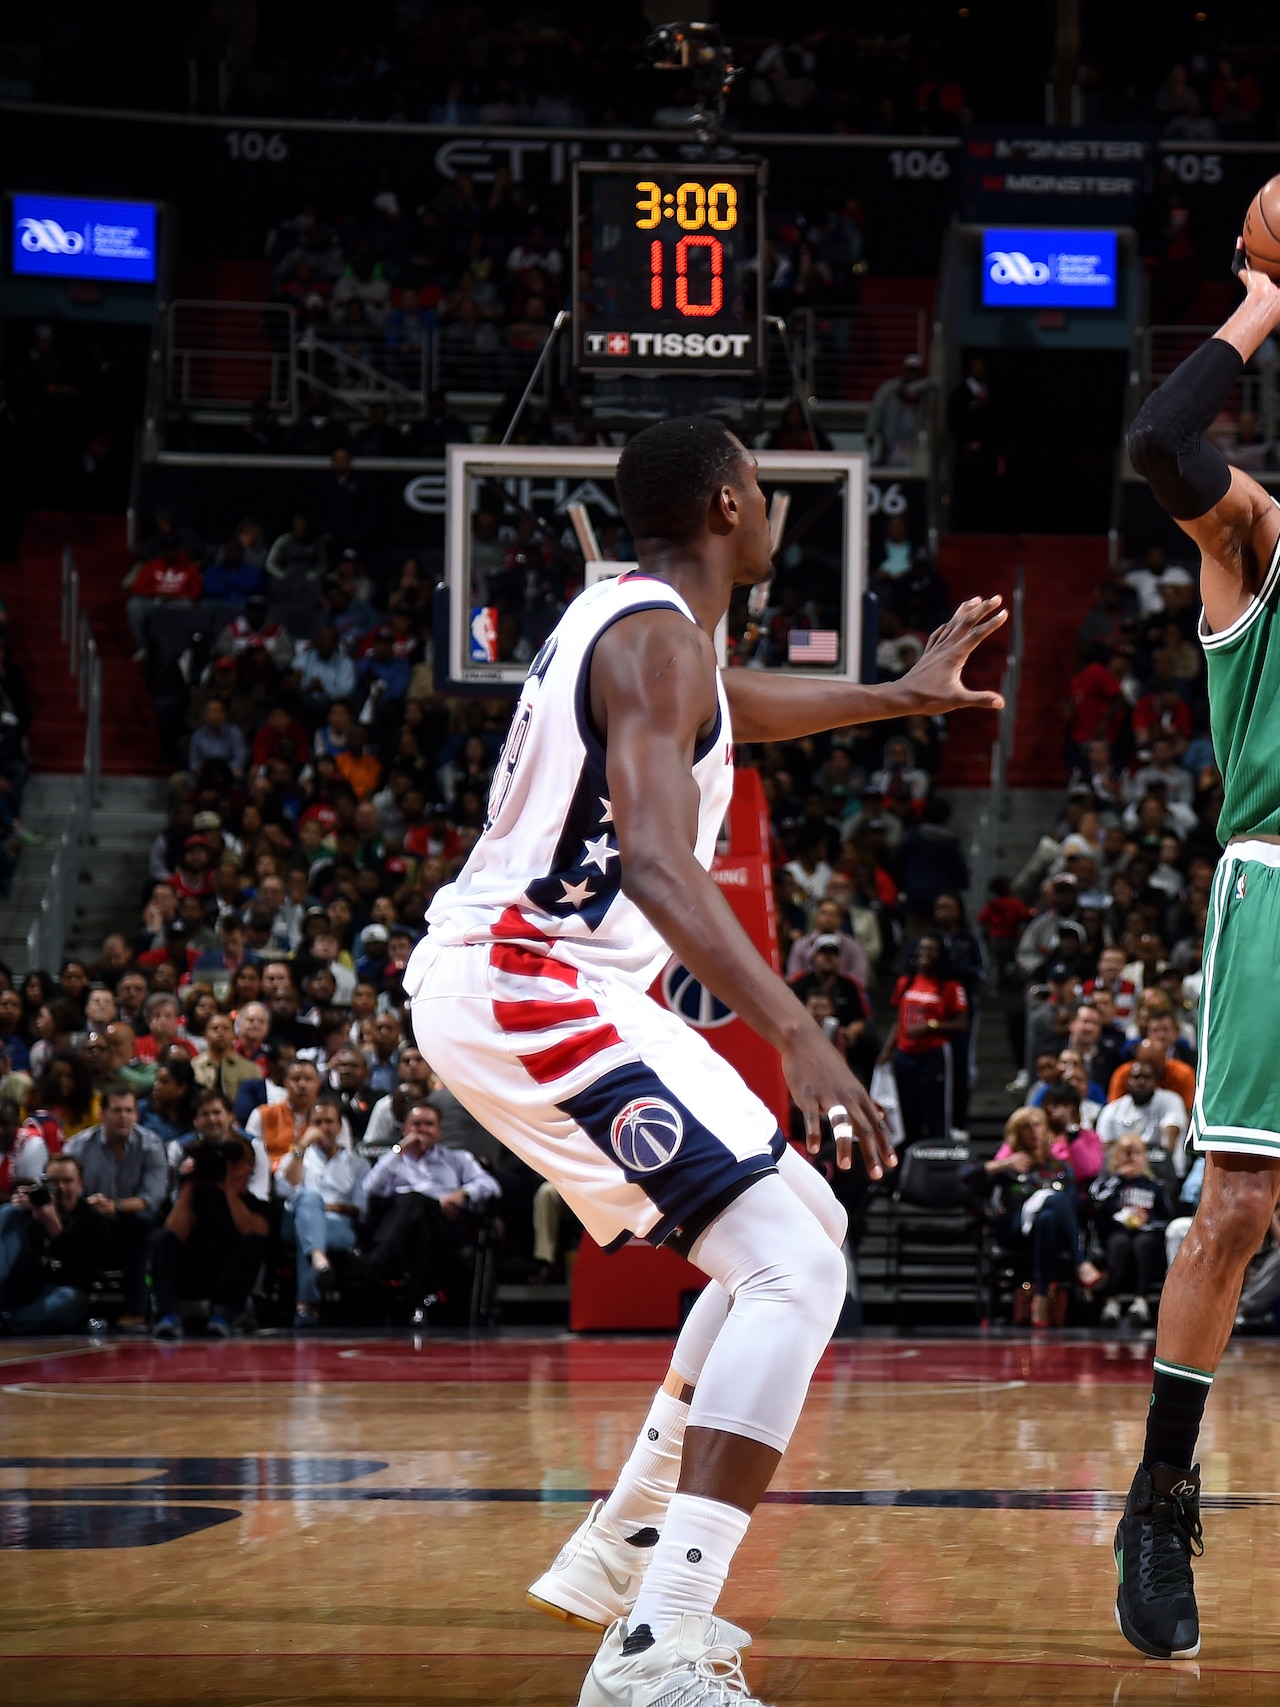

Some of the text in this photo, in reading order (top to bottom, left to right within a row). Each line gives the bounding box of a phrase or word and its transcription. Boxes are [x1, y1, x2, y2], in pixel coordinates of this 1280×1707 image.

[224, 130, 290, 162] 106
[887, 149, 950, 181] 106
[634, 181, 738, 231] 3:00
[649, 233, 724, 317] 10
[630, 332, 751, 357] TISSOT
